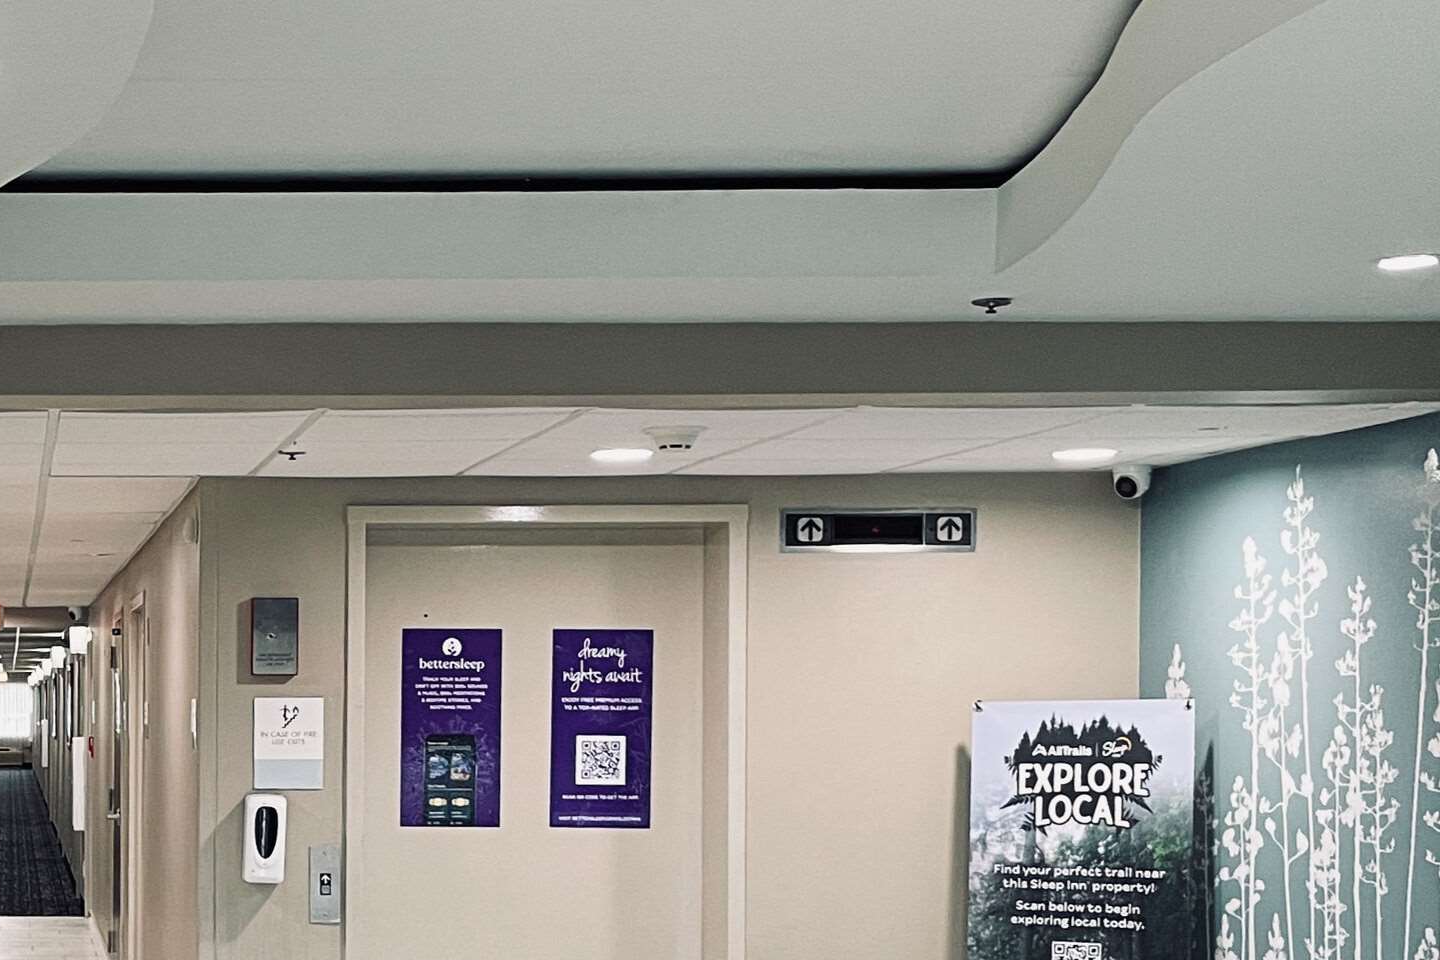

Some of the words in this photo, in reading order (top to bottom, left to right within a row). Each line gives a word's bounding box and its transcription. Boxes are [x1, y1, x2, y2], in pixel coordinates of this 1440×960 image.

[578, 638, 627, 668] dreamy
[419, 658, 485, 672] bettersleep
[562, 659, 603, 693] nights
[605, 667, 643, 684] await
[1047, 743, 1093, 757] AllTrails
[1017, 762, 1151, 796] EXPLORE
[1035, 794, 1132, 828] LOCAL
[993, 863, 1021, 875] Find
[1022, 866, 1051, 876] your
[1053, 865, 1103, 878] perfect
[1104, 867, 1133, 878] trail
[1135, 869, 1166, 880] near
[1002, 878, 1028, 889] this
[1029, 879, 1065, 891] Sleep
[1091, 882, 1156, 895] property!
[1015, 900, 1046, 912] Scan
[1048, 901, 1086, 914] below
[1087, 903, 1103, 914] to
[1104, 904, 1141, 917] begin
[1010, 914, 1069, 929] exploring
[1070, 916, 1101, 928] local
[1102, 917, 1146, 932] today.
